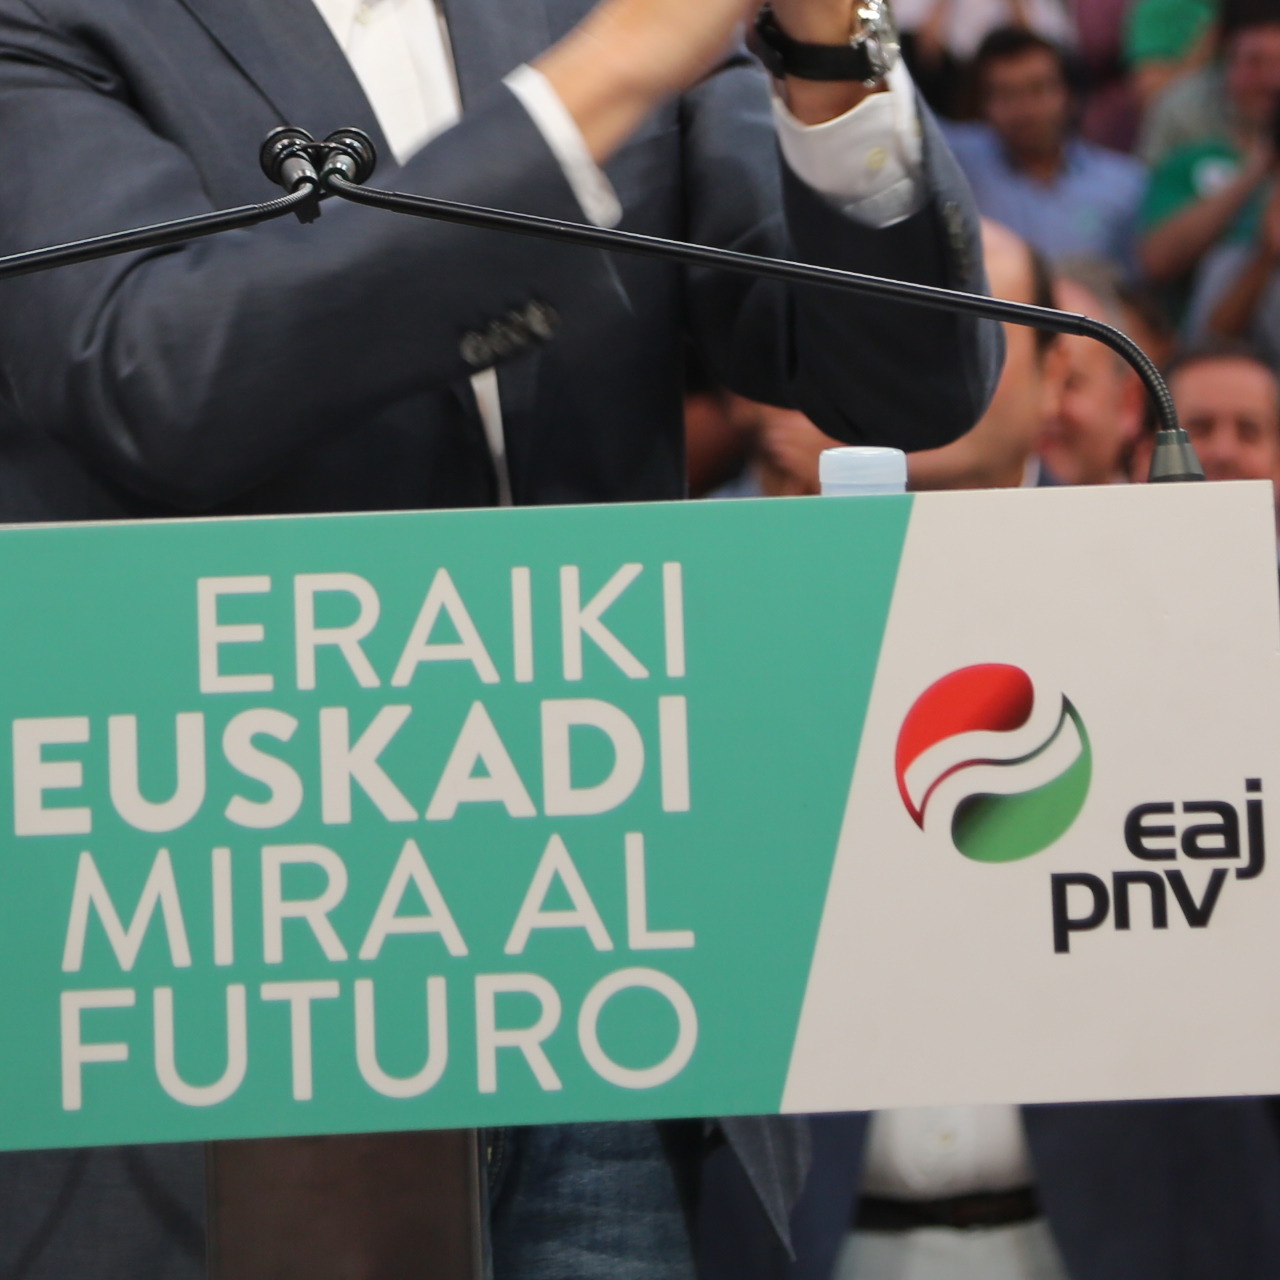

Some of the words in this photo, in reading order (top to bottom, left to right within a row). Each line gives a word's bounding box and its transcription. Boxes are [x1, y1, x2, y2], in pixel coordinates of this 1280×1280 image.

[195, 560, 687, 695] ERAIKI
[11, 693, 692, 838] EUSKADI
[1122, 777, 1266, 883] eaj
[60, 837, 470, 973] MIRA
[503, 830, 696, 956] AL
[1049, 868, 1230, 955] pnv
[59, 966, 699, 1112] FUTURO
